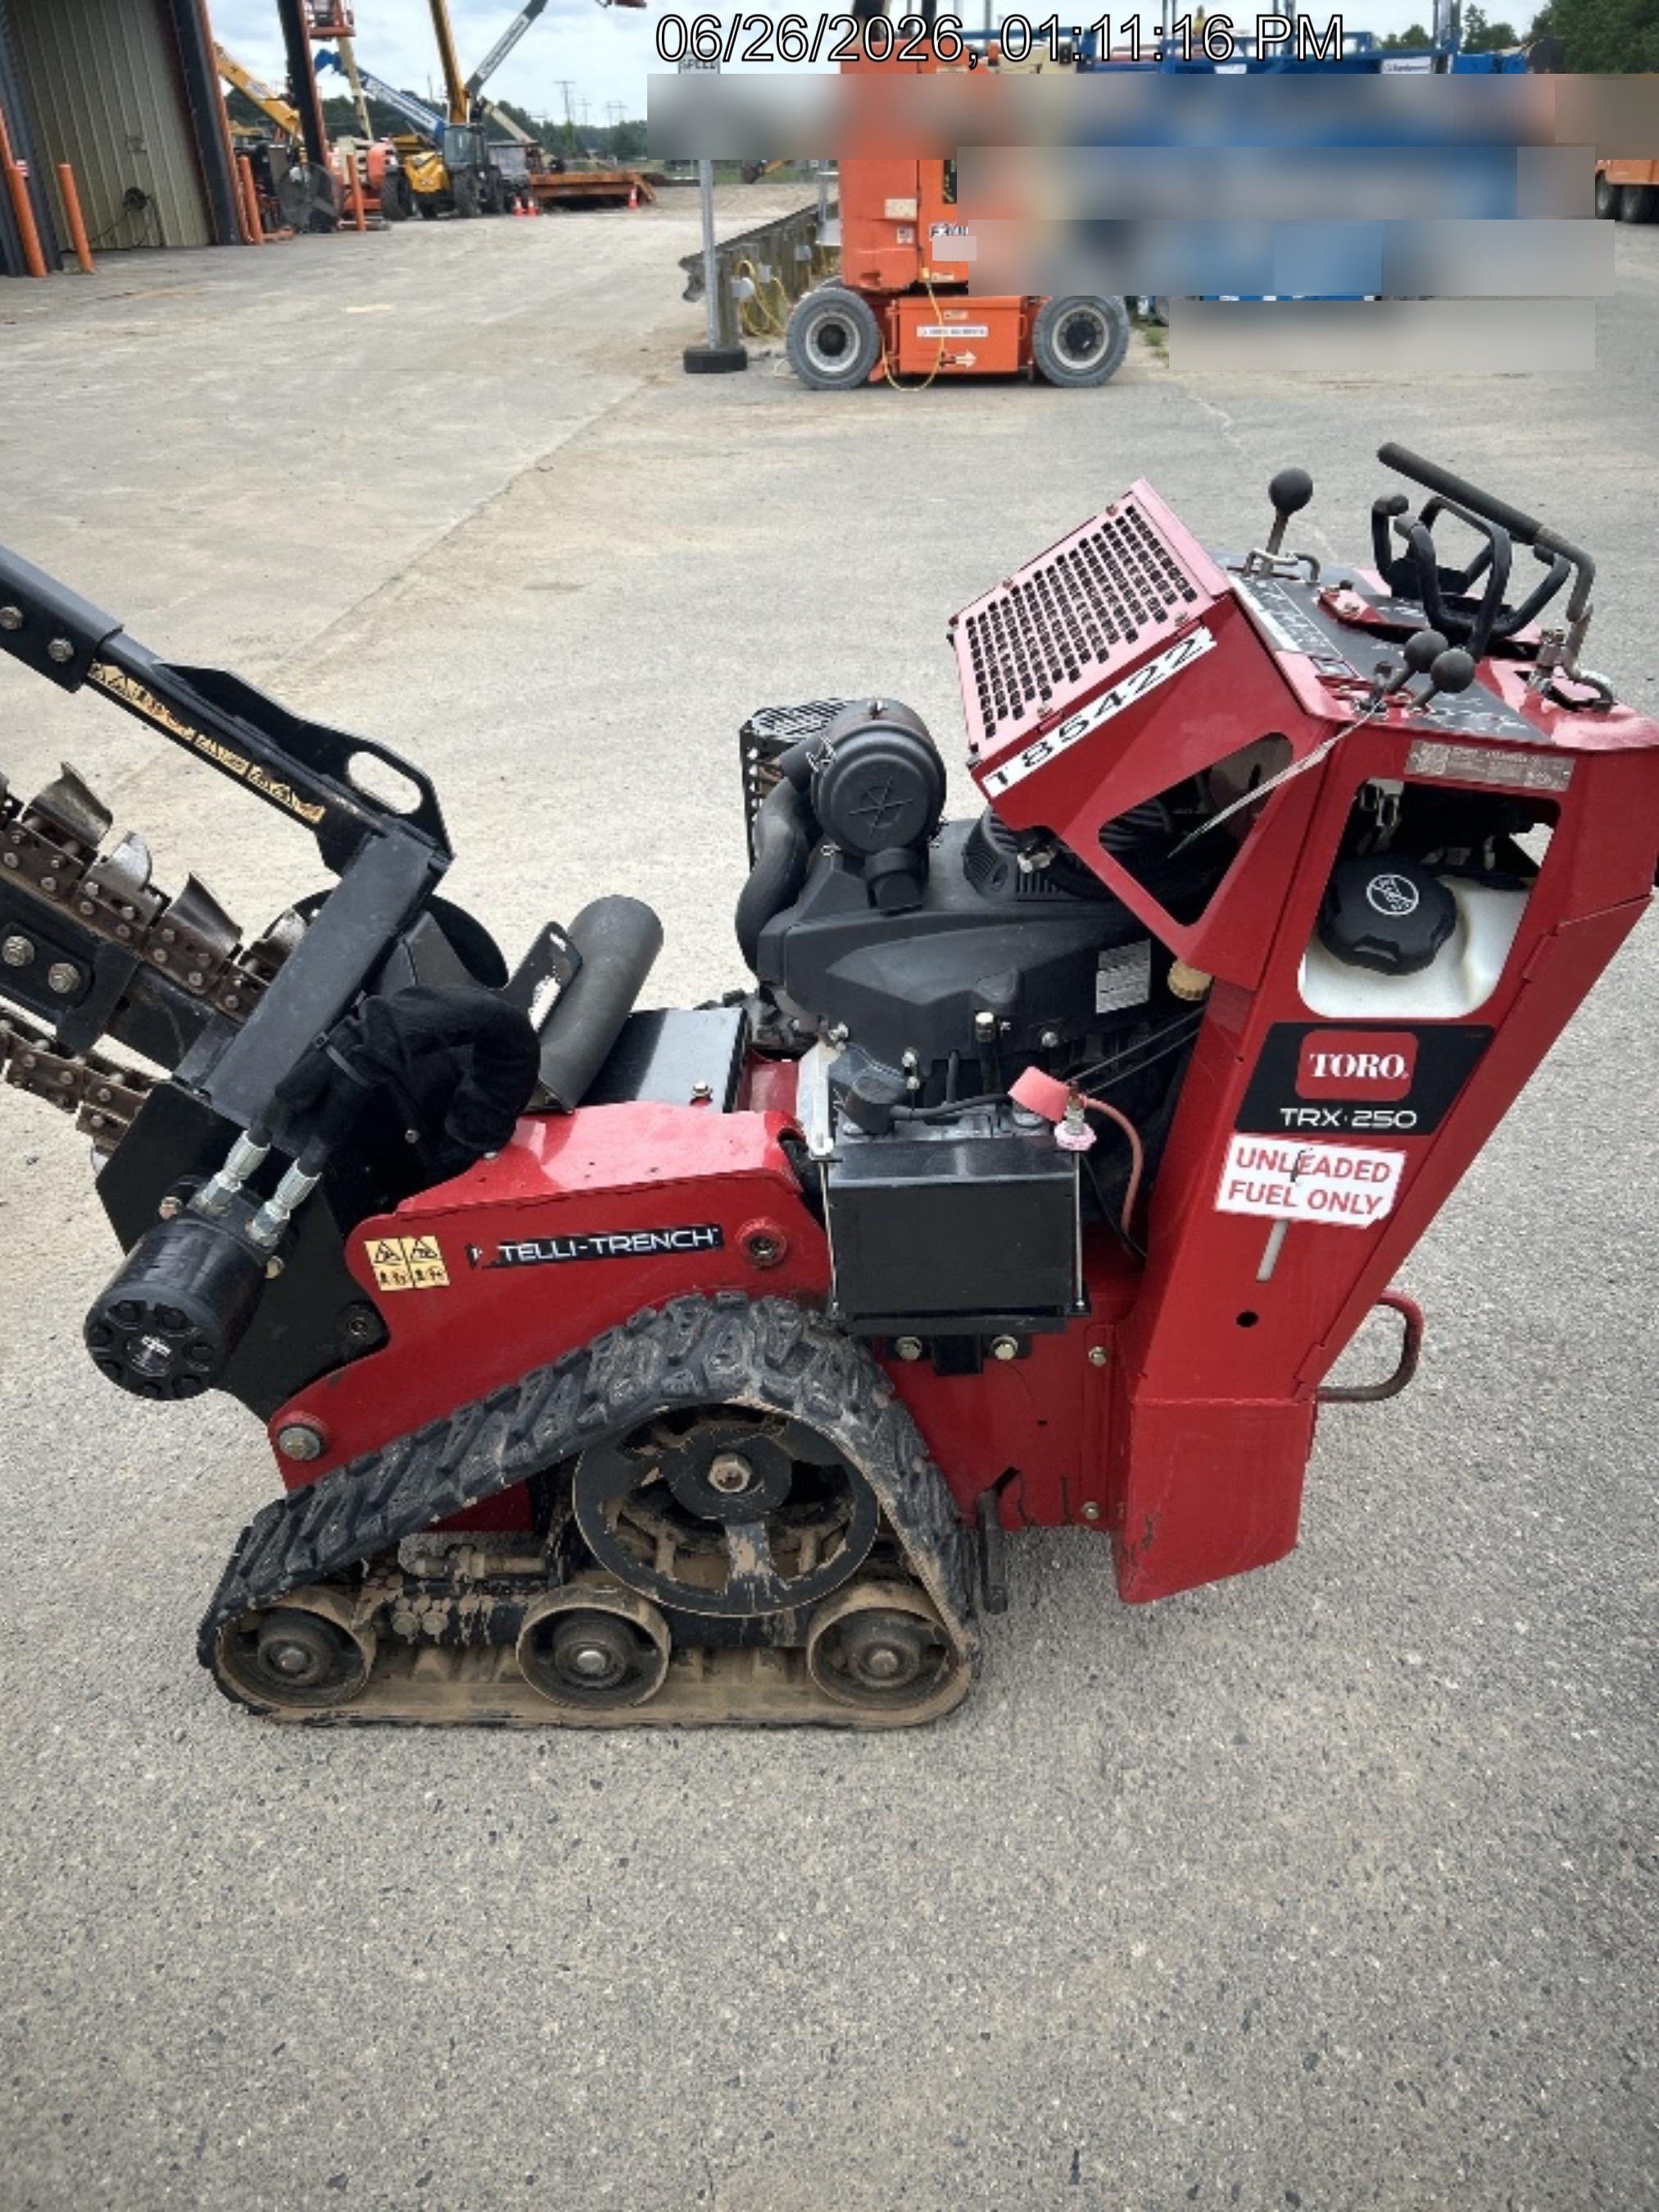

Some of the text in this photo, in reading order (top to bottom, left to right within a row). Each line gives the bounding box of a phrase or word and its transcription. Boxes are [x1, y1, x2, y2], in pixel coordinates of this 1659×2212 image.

[986, 638, 1203, 786] 185422
[1309, 1054, 1407, 1079] TORO
[1235, 1147, 1392, 1183] UNLEADED
[1228, 1180, 1384, 1215] FUEL ONLY
